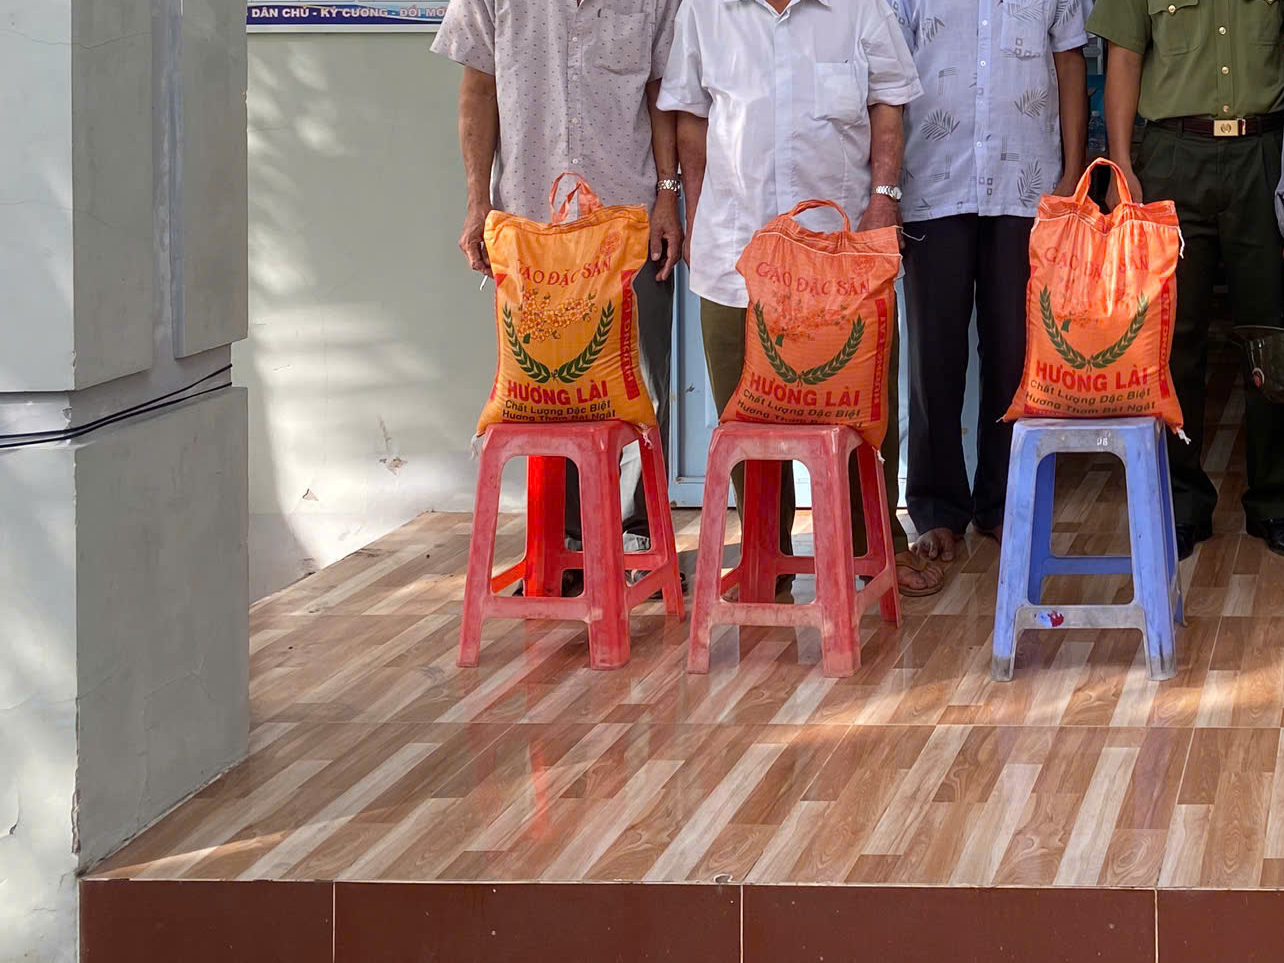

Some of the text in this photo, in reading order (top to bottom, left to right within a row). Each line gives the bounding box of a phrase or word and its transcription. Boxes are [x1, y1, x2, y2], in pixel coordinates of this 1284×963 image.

[251, 7, 279, 17] DÂN
[282, 5, 309, 17] CHỦ
[342, 7, 388, 17] CƯƠNG
[750, 372, 817, 406] HƯƠNG
[1035, 360, 1108, 393] HƯƠNG
[508, 379, 608, 406] HƯƠNG LÀI
